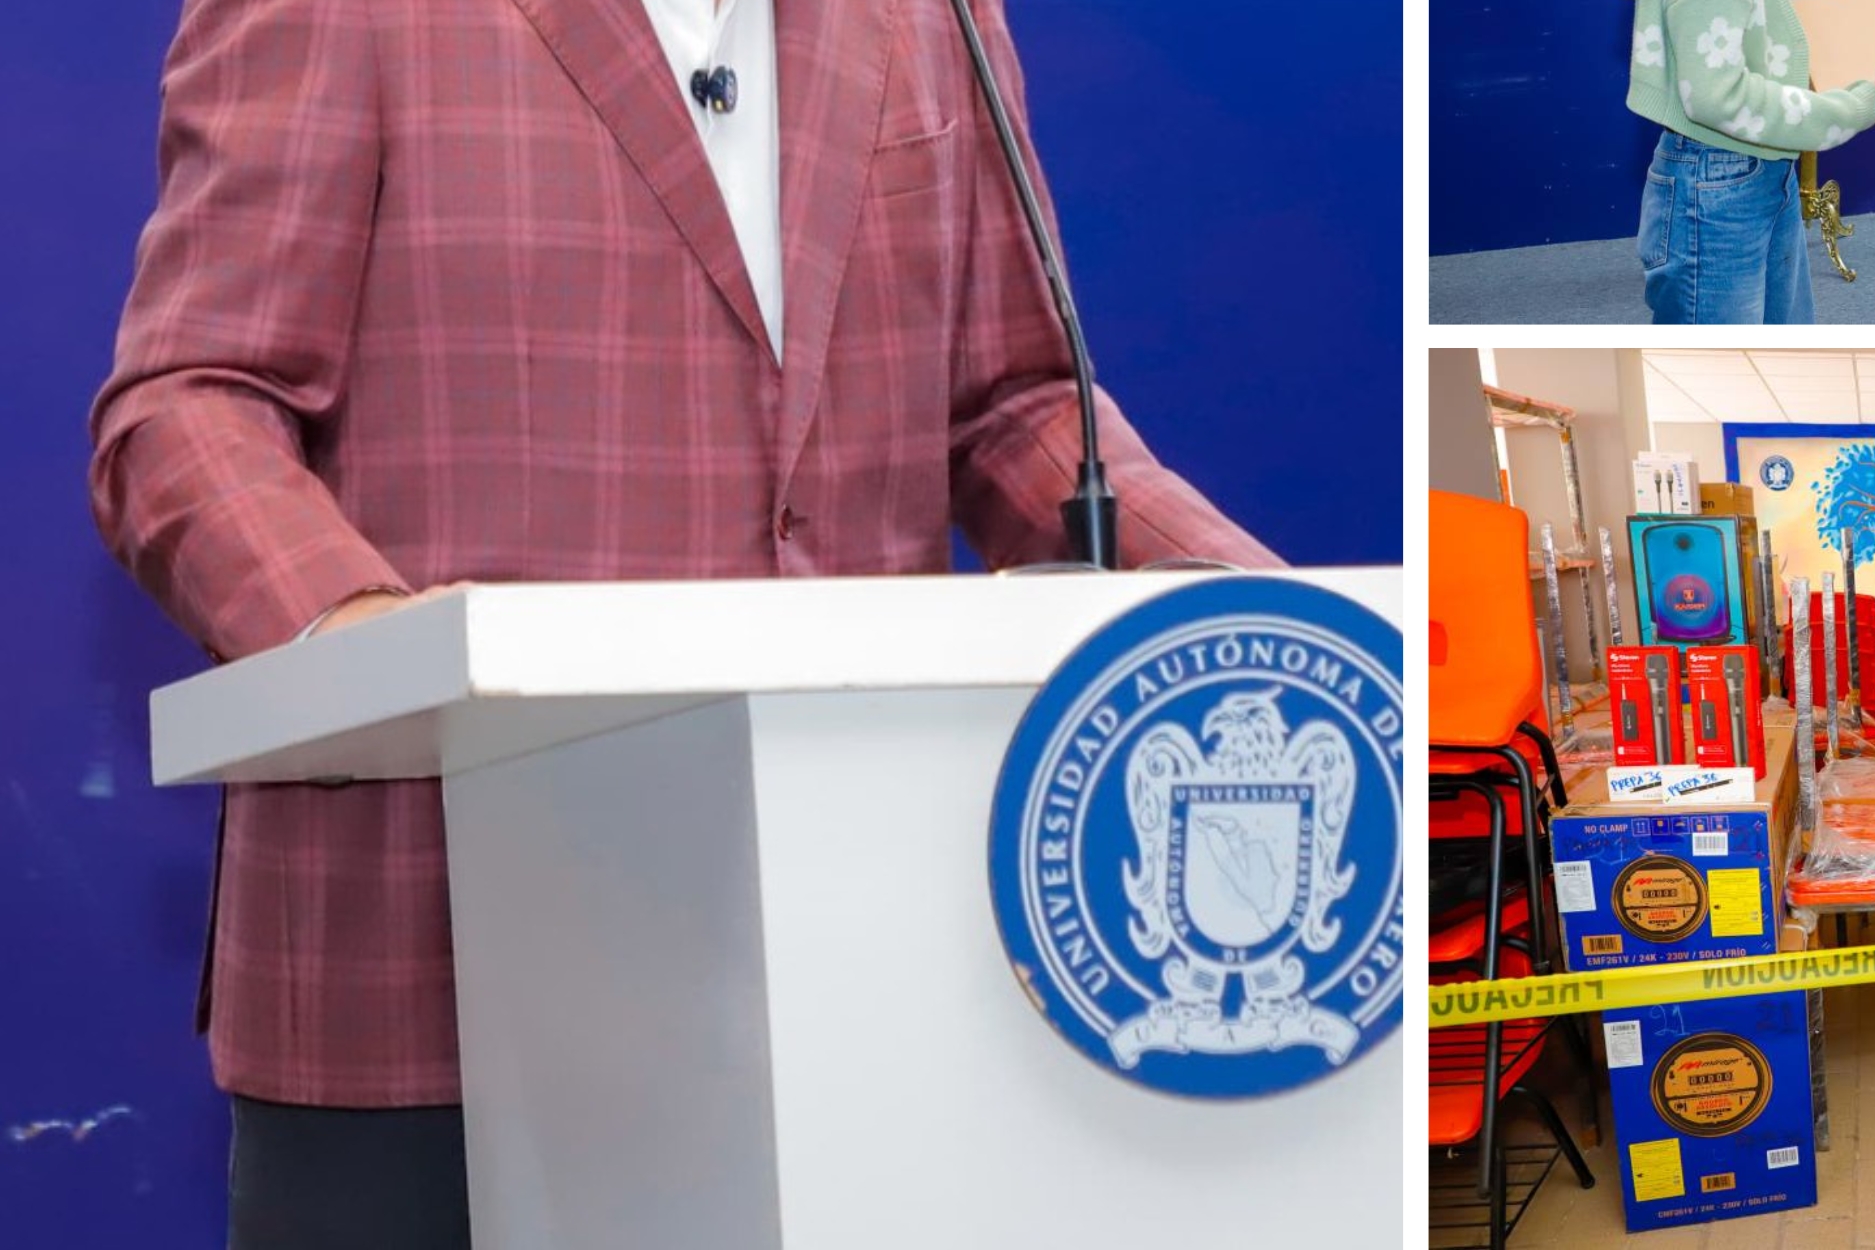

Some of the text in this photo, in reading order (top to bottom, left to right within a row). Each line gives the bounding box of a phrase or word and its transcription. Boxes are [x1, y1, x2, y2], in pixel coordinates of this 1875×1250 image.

[1174, 788, 1310, 801] UNIVERSIDAD
[1041, 636, 1403, 996] UNIVERSIDAD AUTÓNOMA DE
[1585, 824, 1628, 833] NO CLAMP
[1224, 950, 1248, 961] DE
